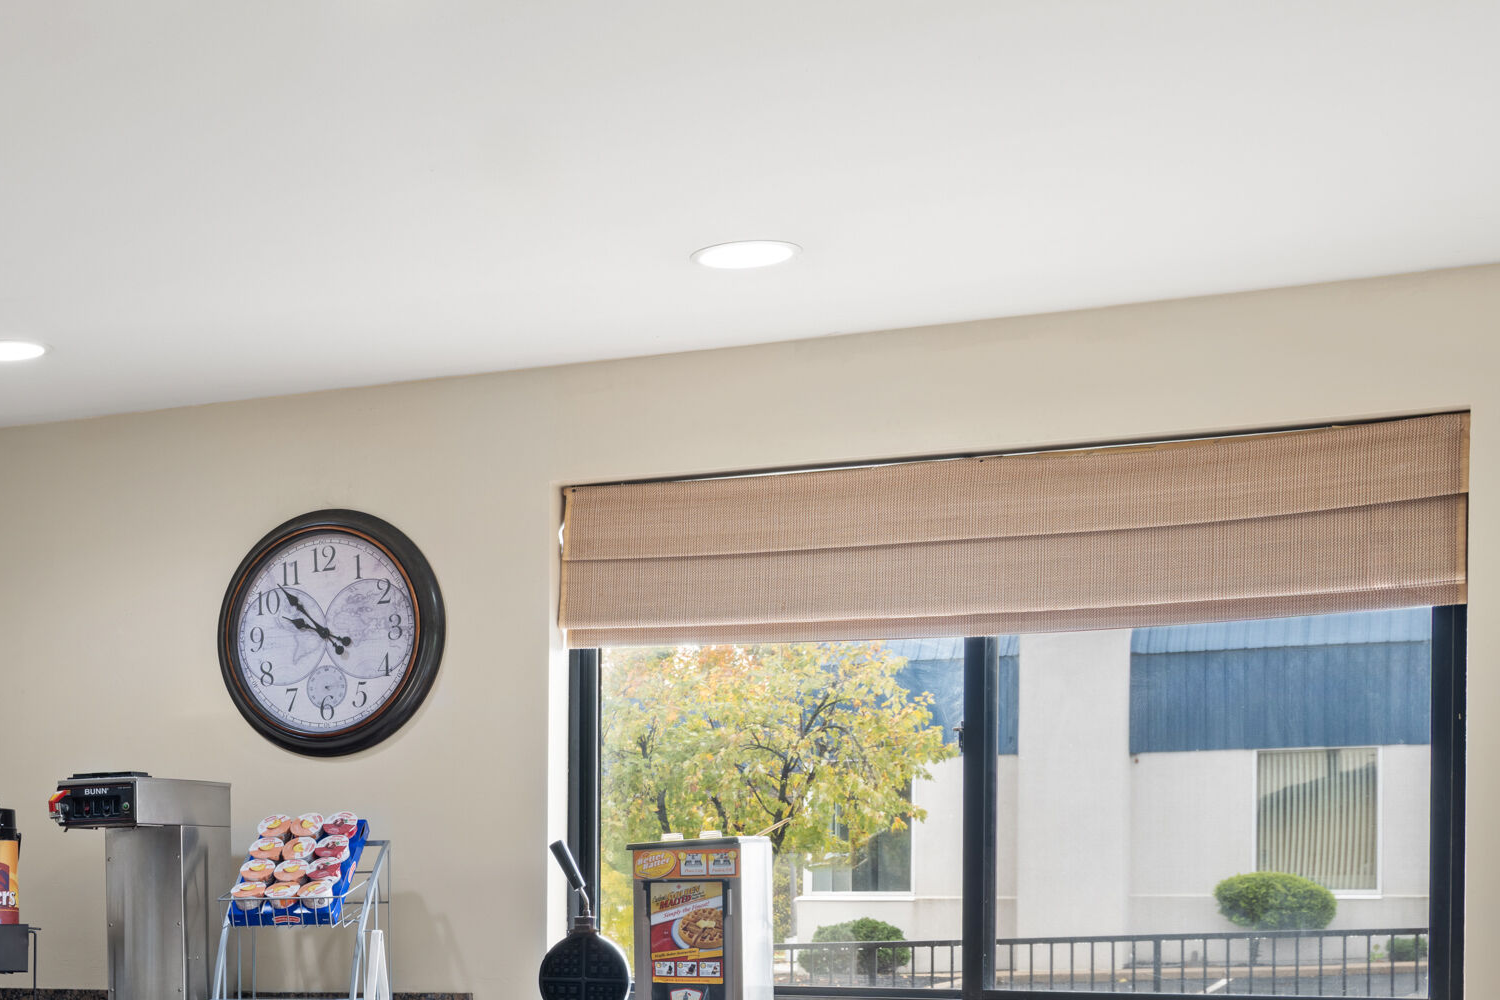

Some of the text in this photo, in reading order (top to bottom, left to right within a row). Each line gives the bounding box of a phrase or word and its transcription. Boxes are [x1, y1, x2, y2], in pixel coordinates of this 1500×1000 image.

[311, 545, 336, 573] 12
[353, 554, 362, 580] 1
[281, 560, 300, 587] 11
[255, 589, 281, 617] 10
[377, 578, 392, 605] 2
[250, 627, 264, 653] 9
[388, 614, 402, 640] 3
[260, 661, 274, 687] 8
[378, 652, 392, 677] 4
[286, 688, 298, 712] 7
[352, 681, 367, 708] 5
[320, 695, 334, 721] 6
[84, 788, 108, 796] BUNN
[637, 852, 665, 866] Better
[642, 857, 671, 870] Batter
[659, 895, 692, 910] MALTED
